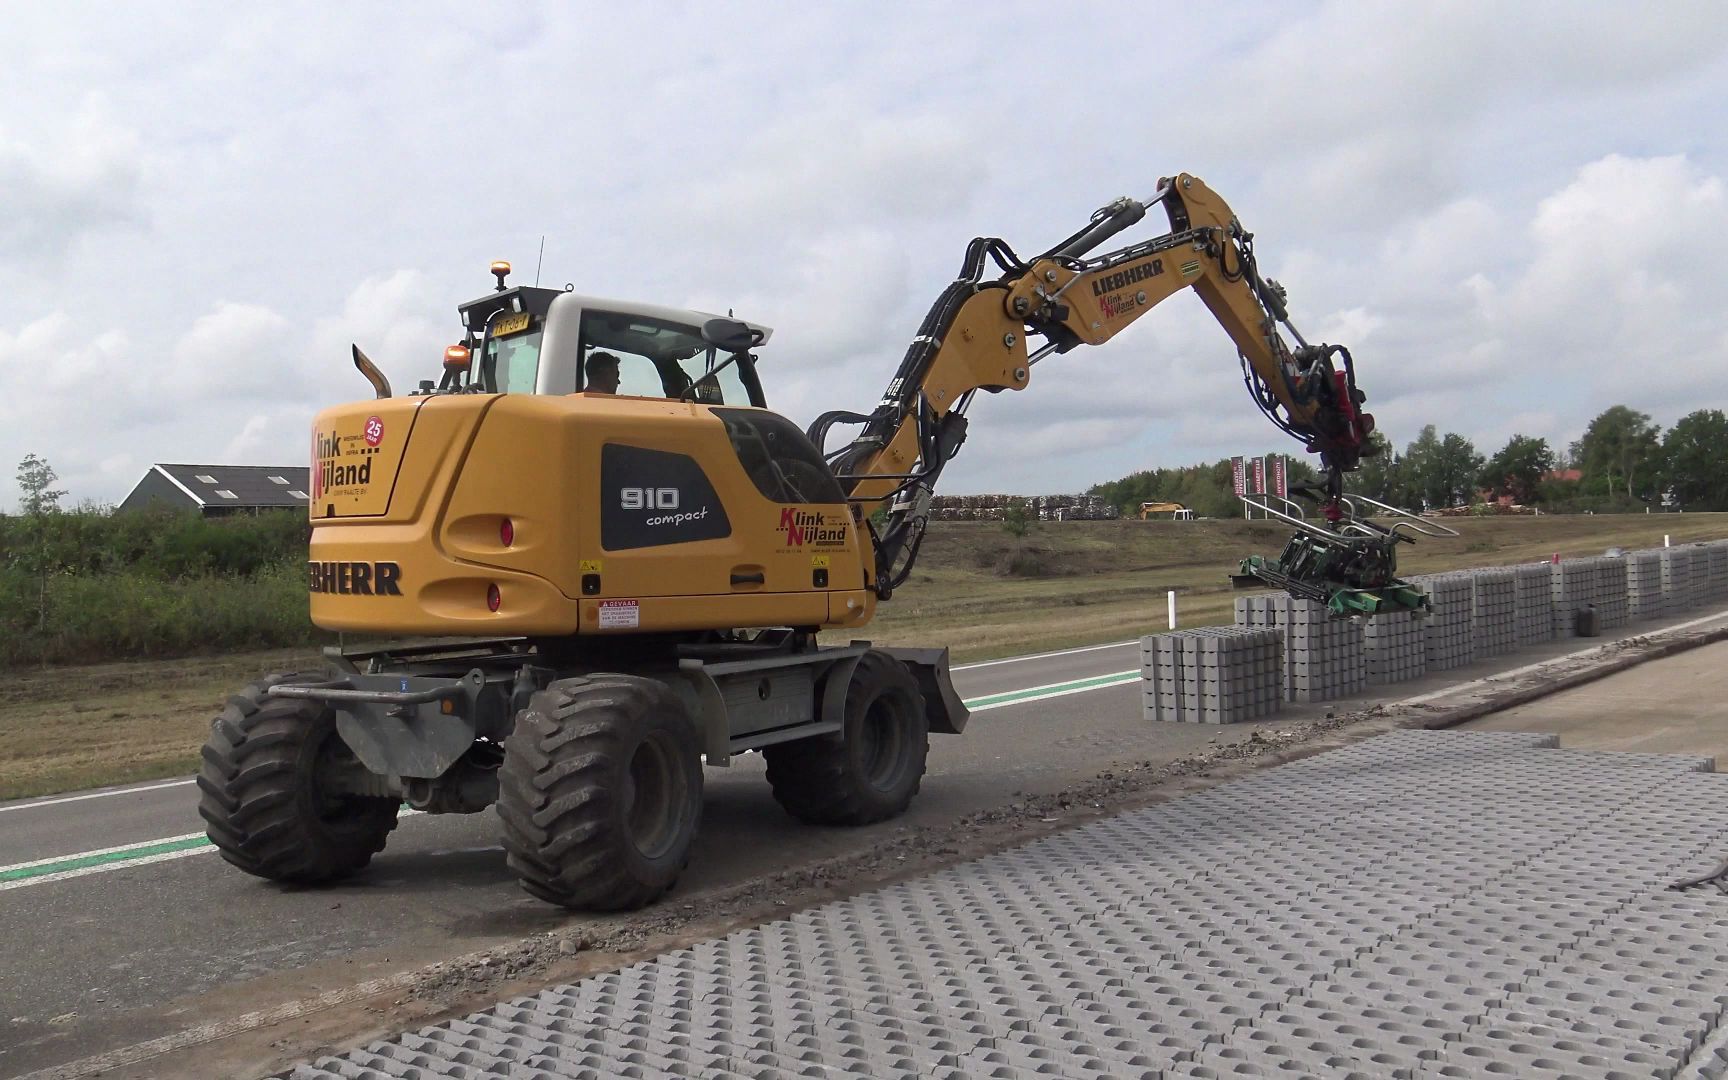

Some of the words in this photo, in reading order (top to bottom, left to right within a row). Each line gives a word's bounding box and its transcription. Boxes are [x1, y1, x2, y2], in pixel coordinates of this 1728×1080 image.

[1092, 259, 1164, 296] LIEBHERR
[367, 420, 382, 437] 25
[620, 486, 680, 510] 910
[646, 505, 708, 526] compact
[780, 507, 825, 528] Klink
[786, 526, 846, 546] Nijland
